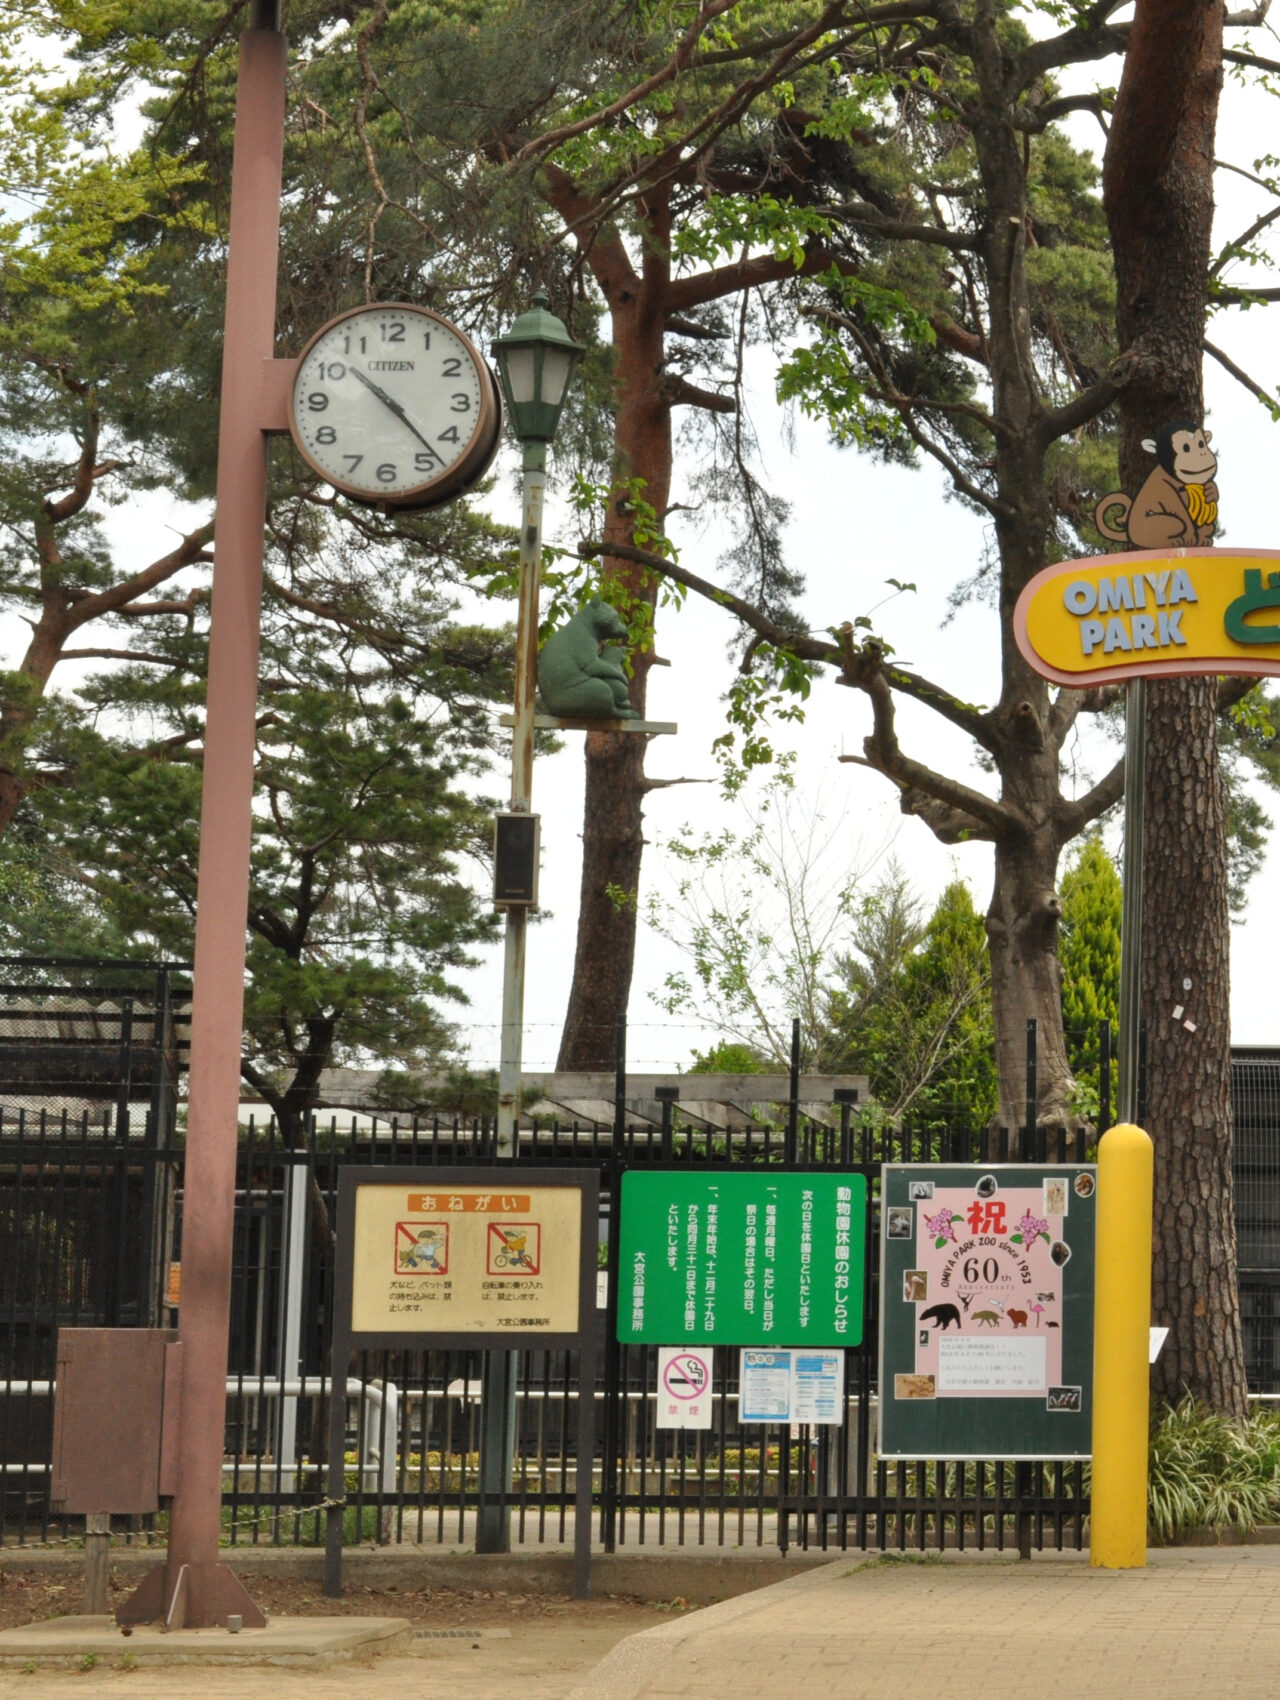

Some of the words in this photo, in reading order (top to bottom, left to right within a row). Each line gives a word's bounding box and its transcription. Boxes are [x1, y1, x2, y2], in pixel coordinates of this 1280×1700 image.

[380, 323, 405, 342] 12
[424, 332, 431, 350] 1
[344, 336, 367, 354] 11
[318, 362, 346, 381] 10
[368, 361, 415, 371] CITIZEN
[442, 358, 461, 377] 2
[308, 392, 329, 412] 9
[450, 393, 471, 412] 3
[315, 426, 337, 445] 8
[437, 426, 460, 444] 4
[343, 455, 364, 473] 7
[414, 453, 434, 472] 5
[376, 463, 397, 483] 6
[1064, 568, 1198, 616] OMIYA
[1080, 610, 1187, 655] PARK
[421, 1195, 517, 1211] おねがい
[967, 1201, 1008, 1235] 祝
[667, 1204, 679, 1272] といたします。
[800, 1190, 813, 1328] 次の日を休園日といたします
[834, 1187, 851, 1333] 動物園休園のおしらせ
[941, 1259, 957, 1288] OMIYA
[953, 1240, 977, 1260] PARK
[978, 1236, 997, 1246] ZOO
[998, 1240, 1020, 1259] since
[1017, 1260, 1032, 1284] 1953
[632, 1252, 646, 1331] 大宮公園事務所
[668, 1404, 699, 1416] 禁煙
